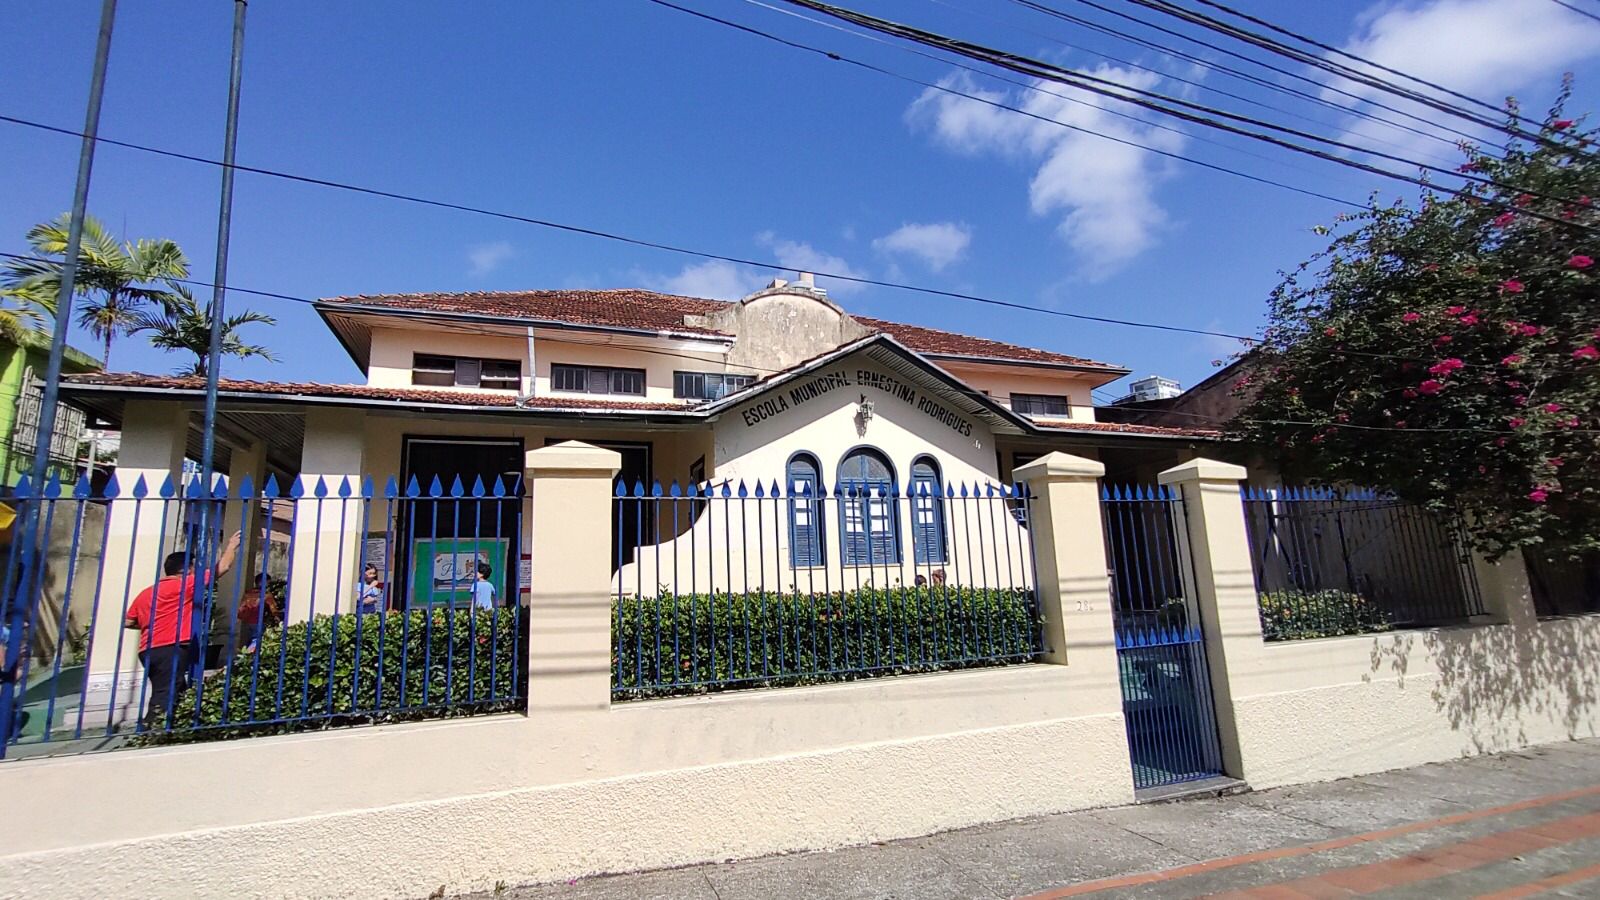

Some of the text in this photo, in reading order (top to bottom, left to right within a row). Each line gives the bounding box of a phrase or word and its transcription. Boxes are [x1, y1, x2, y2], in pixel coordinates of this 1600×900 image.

[742, 369, 972, 437] ESCOLA MUNICIPAL ERNESTINA RODRIGUES
